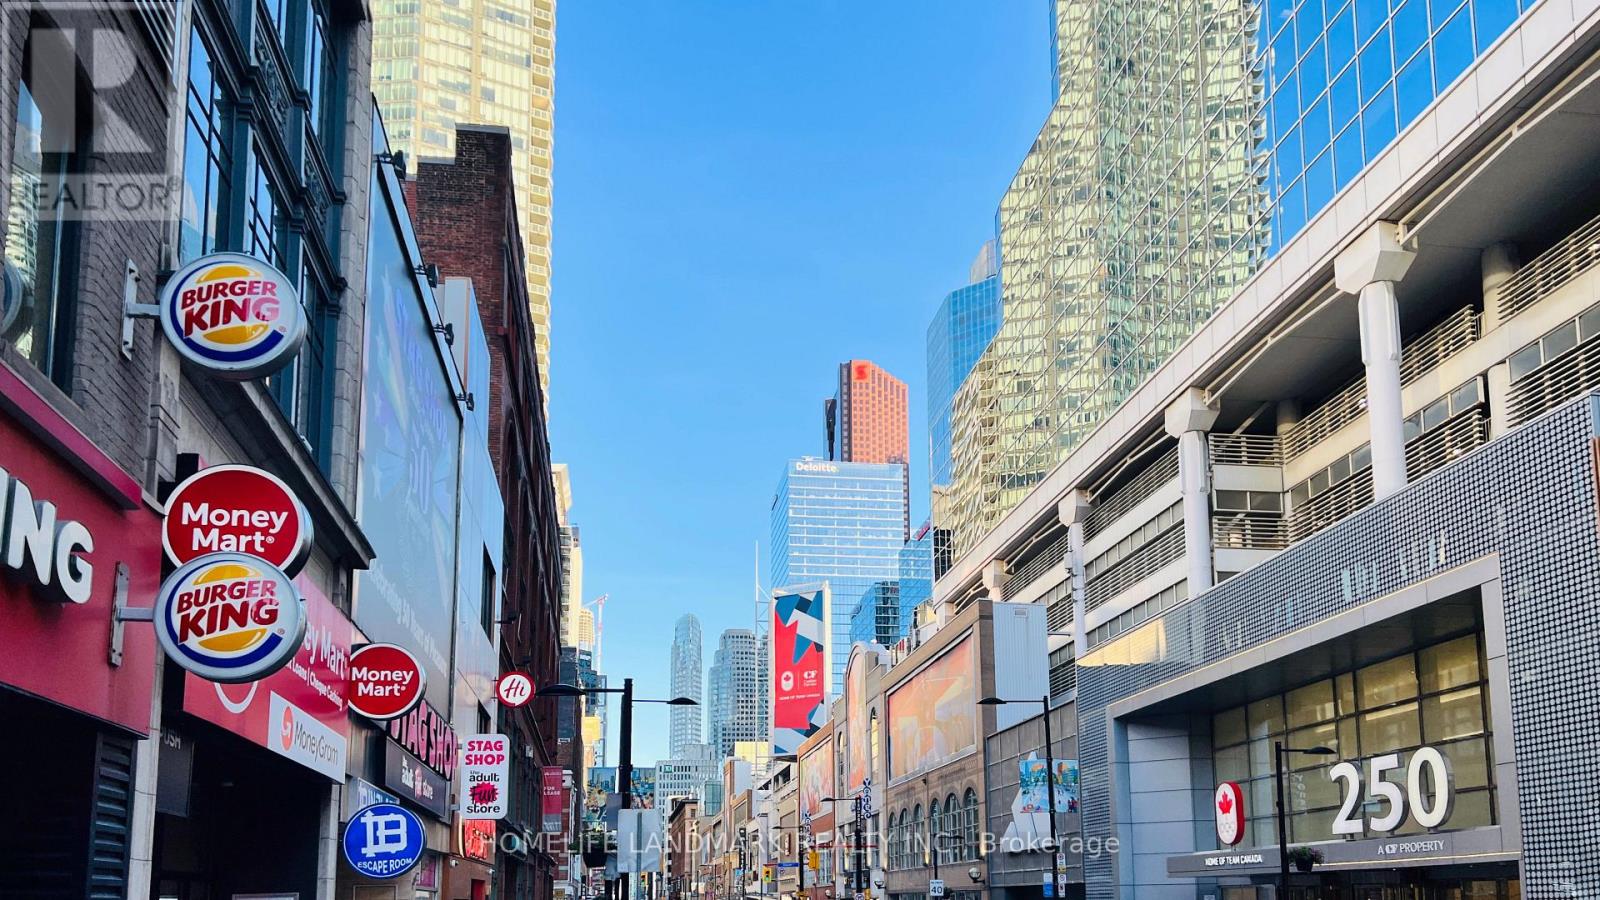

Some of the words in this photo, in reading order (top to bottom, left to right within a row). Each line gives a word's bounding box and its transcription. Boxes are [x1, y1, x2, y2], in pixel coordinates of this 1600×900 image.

[181, 280, 277, 310] BURGER
[183, 297, 280, 337] KING
[181, 502, 288, 533] Money
[192, 528, 266, 552] Mart
[176, 580, 277, 614] BURGER
[178, 599, 279, 644] KING
[320, 625, 345, 681] Mart
[351, 667, 414, 685] Money
[358, 682, 401, 697] Mart
[504, 678, 525, 698] Hi
[294, 720, 339, 767] MoneyGram
[429, 710, 459, 782] SHOP
[468, 740, 504, 752] STAG
[465, 754, 505, 765] SHOP
[469, 772, 500, 782] adult
[1329, 747, 1450, 835] 250
[467, 802, 501, 814] store
[1377, 845, 1385, 855] A
[1400, 840, 1445, 853] PROPERTY
[358, 860, 389, 874] ESCAPE
[389, 857, 413, 872] ROOM
[1205, 857, 1219, 866] HOME
[1219, 856, 1226, 866] OF
[1226, 855, 1240, 865] TEAM
[1241, 854, 1263, 864] CANADA
[931, 886, 943, 894] 40
